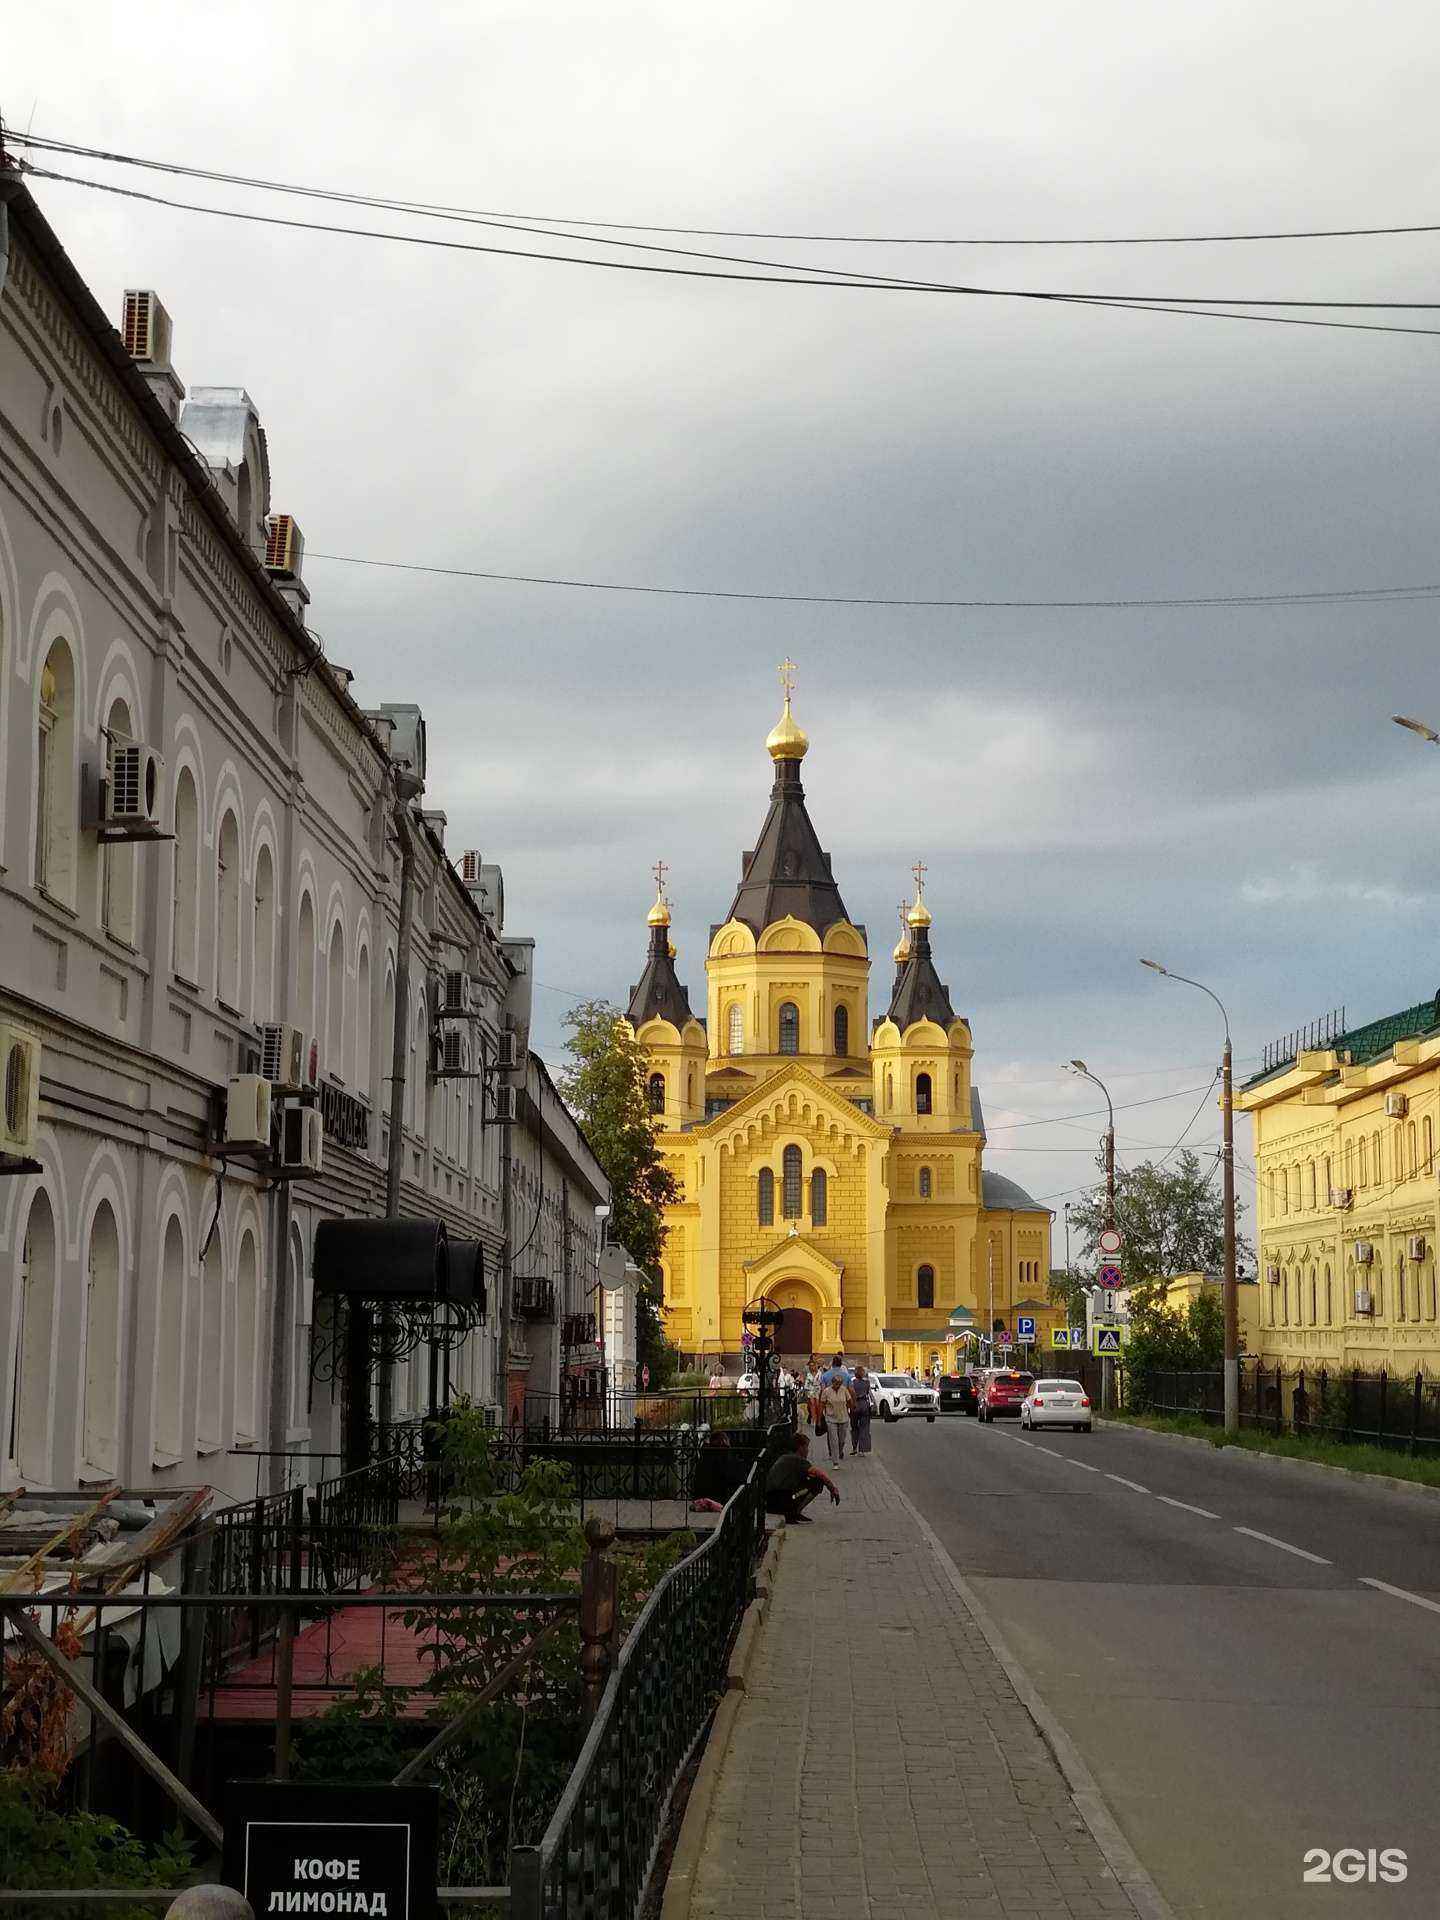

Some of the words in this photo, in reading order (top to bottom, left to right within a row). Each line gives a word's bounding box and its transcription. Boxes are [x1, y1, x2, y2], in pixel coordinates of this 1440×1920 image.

[1022, 1319, 1033, 1333] P
[293, 1858, 361, 1880] КОФЕ
[267, 1891, 388, 1917] ЛИМОНАД
